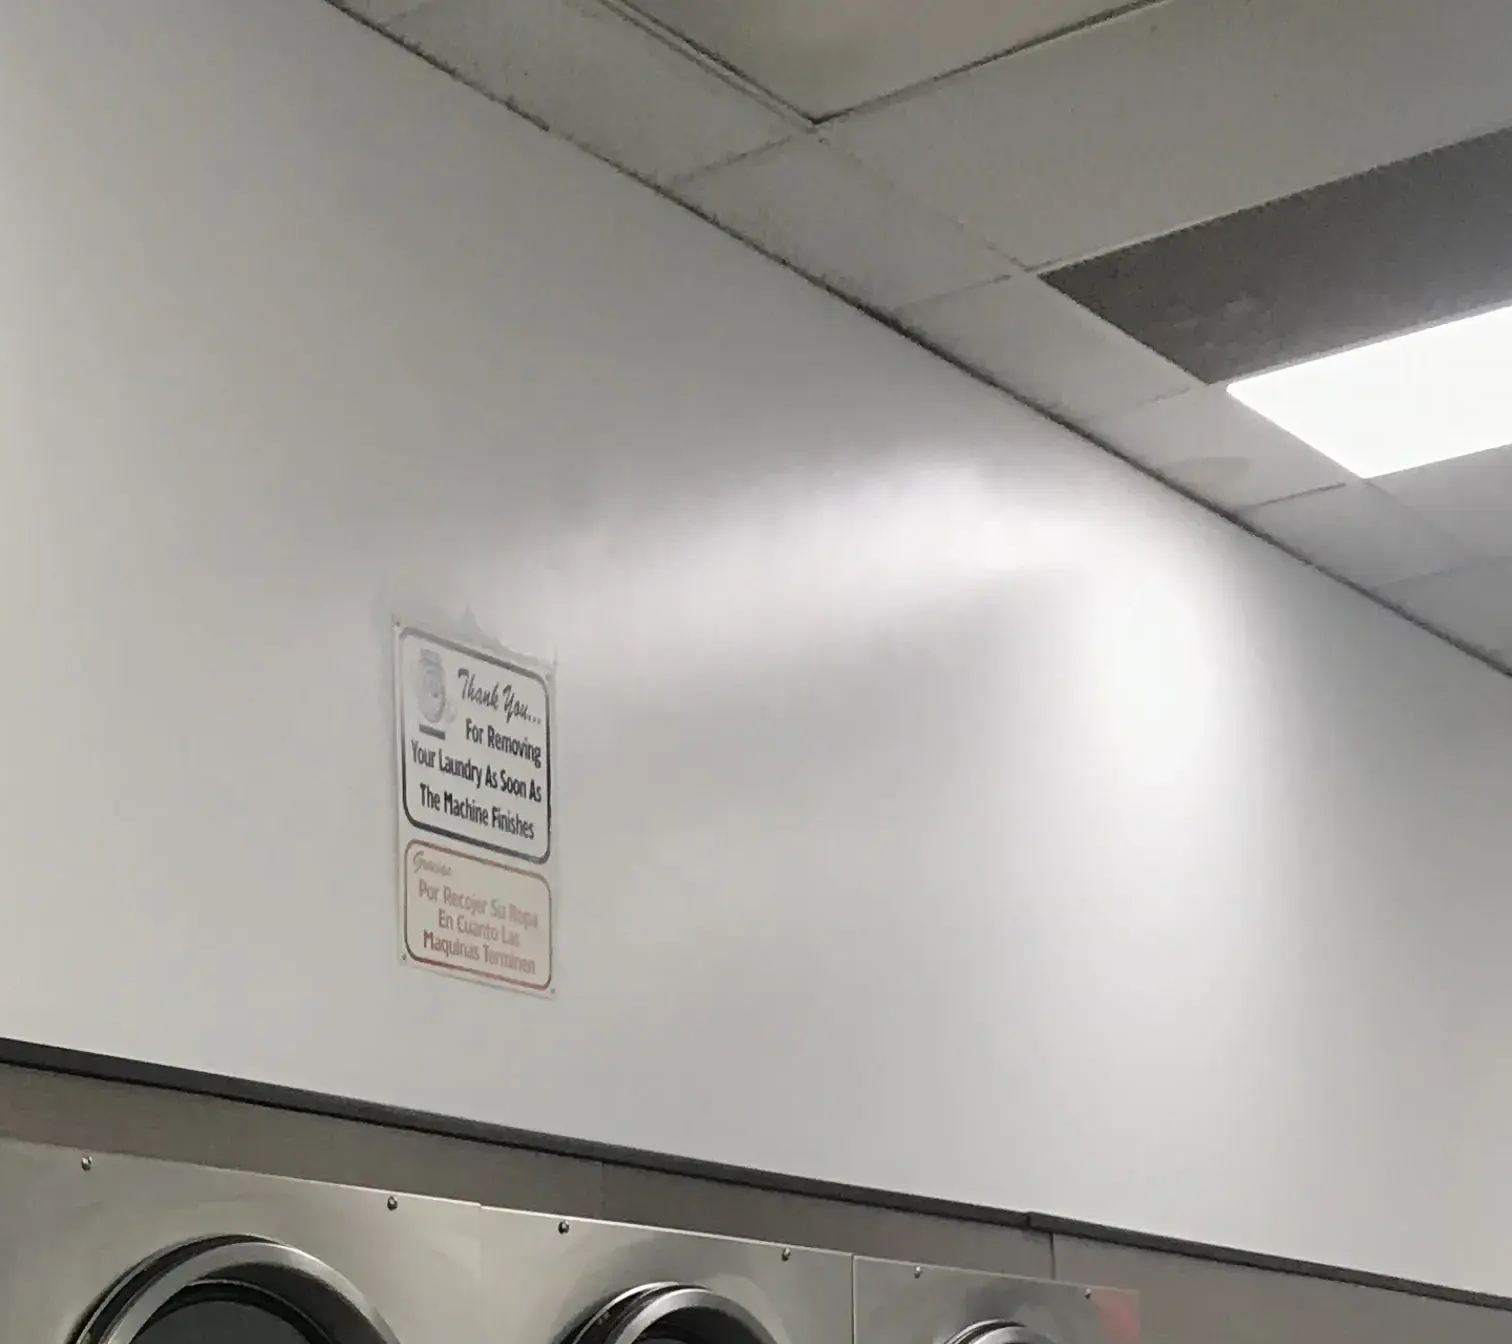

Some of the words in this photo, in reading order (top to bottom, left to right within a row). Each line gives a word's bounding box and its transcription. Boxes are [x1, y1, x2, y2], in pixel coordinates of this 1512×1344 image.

[457, 668, 500, 711] Thank
[465, 718, 484, 745] For
[487, 725, 542, 769] Removing
[411, 739, 436, 769] Your
[438, 748, 483, 789] Laundry
[485, 764, 498, 789] As
[500, 769, 527, 799] Soon
[529, 778, 542, 803] As
[420, 783, 441, 812] The
[443, 790, 489, 826] Machine
[491, 806, 535, 841] Finishes
[418, 879, 441, 903] Por
[491, 899, 506, 919] Su
[438, 908, 454, 931] En
[456, 915, 499, 942] Cuanto
[502, 925, 521, 947] Las
[423, 929, 480, 961] Maquinas
[482, 944, 536, 976] Terminen
